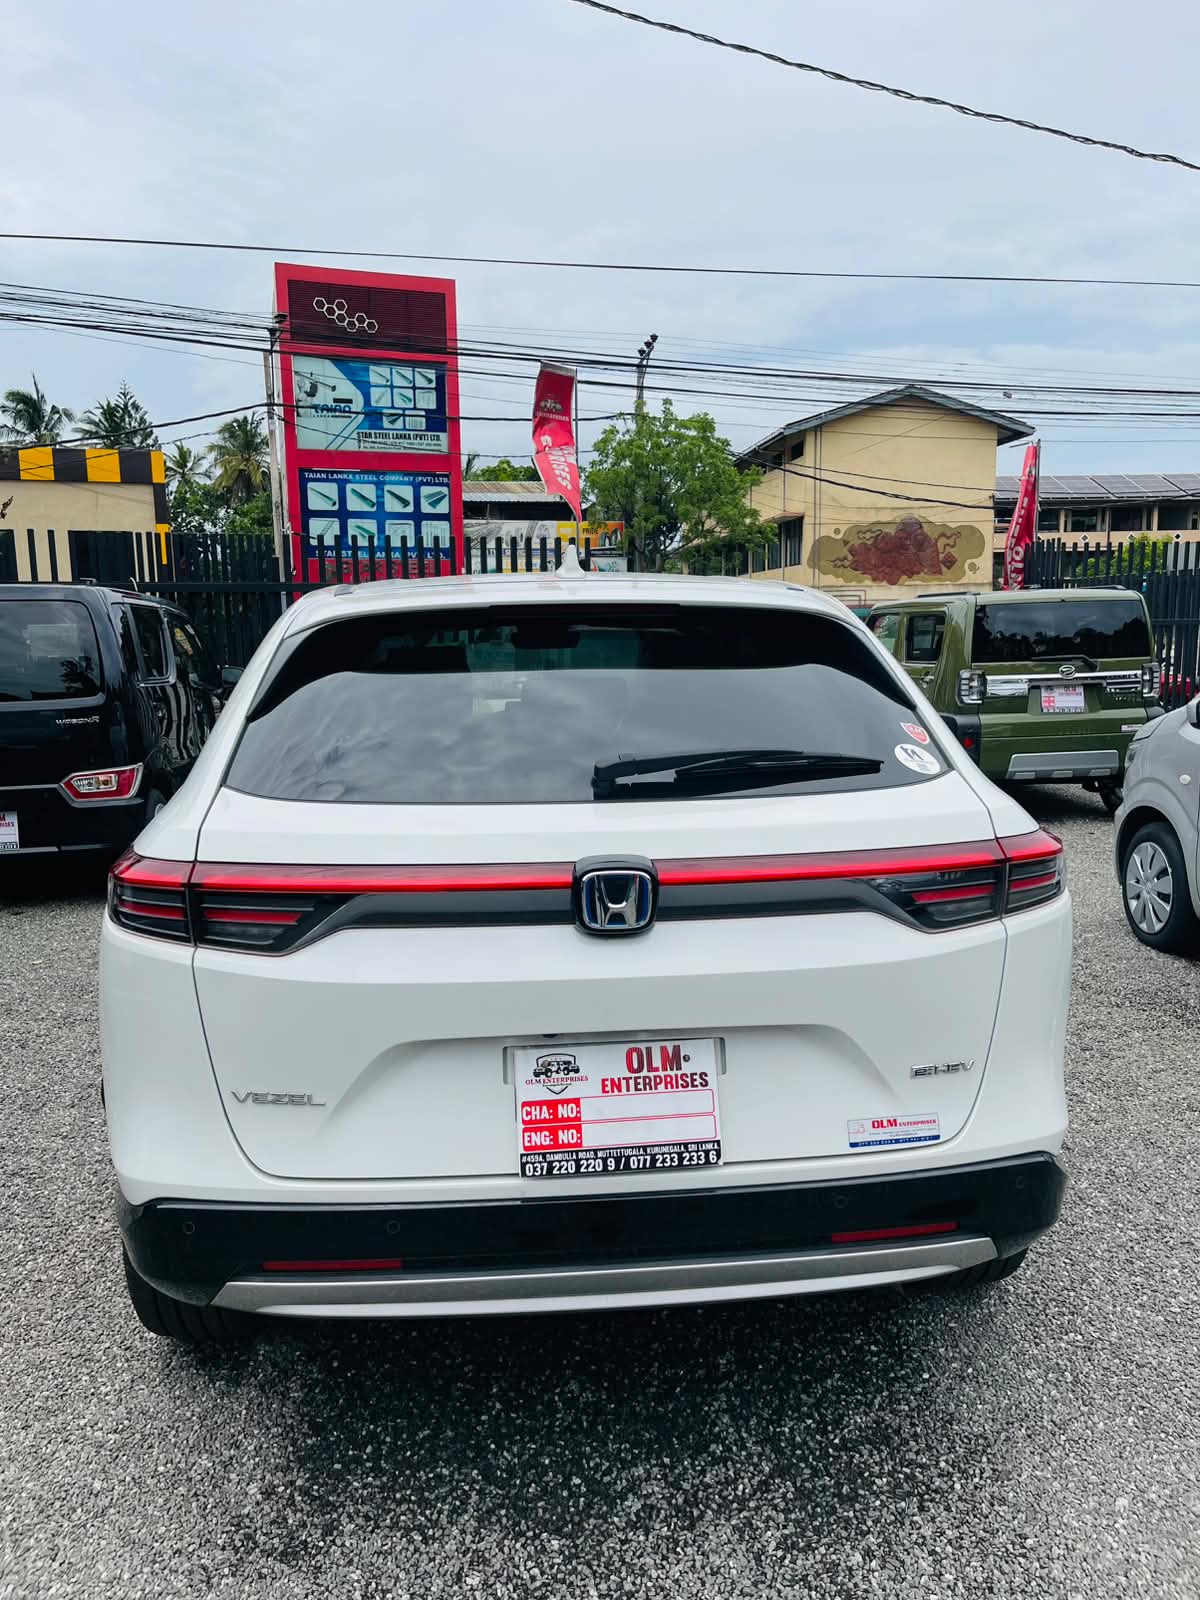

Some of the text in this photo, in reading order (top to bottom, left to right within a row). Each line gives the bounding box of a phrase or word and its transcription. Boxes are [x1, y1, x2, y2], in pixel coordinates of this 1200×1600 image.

[391, 432, 411, 441] LANKA
[328, 472, 353, 480] LANKA
[355, 473, 378, 481] STEEL
[379, 474, 413, 482] COMPANY
[415, 476, 433, 484] (PVT)
[625, 1044, 683, 1074] OLM
[525, 1077, 542, 1085] OLM
[543, 1075, 589, 1084] ENTERPRISES
[601, 1072, 709, 1094] ENTERPRISES
[231, 1091, 326, 1106] VEZEL
[522, 1103, 581, 1121] CHA: NO:
[871, 1118, 898, 1129] OLM
[523, 1129, 582, 1147] ENG: NO:
[546, 1152, 577, 1161] DAMBULLA
[578, 1151, 596, 1159] ROAD,
[688, 1143, 698, 1151] SRI
[525, 1150, 717, 1176] 037 220 220 9 / 077 233 233 6
